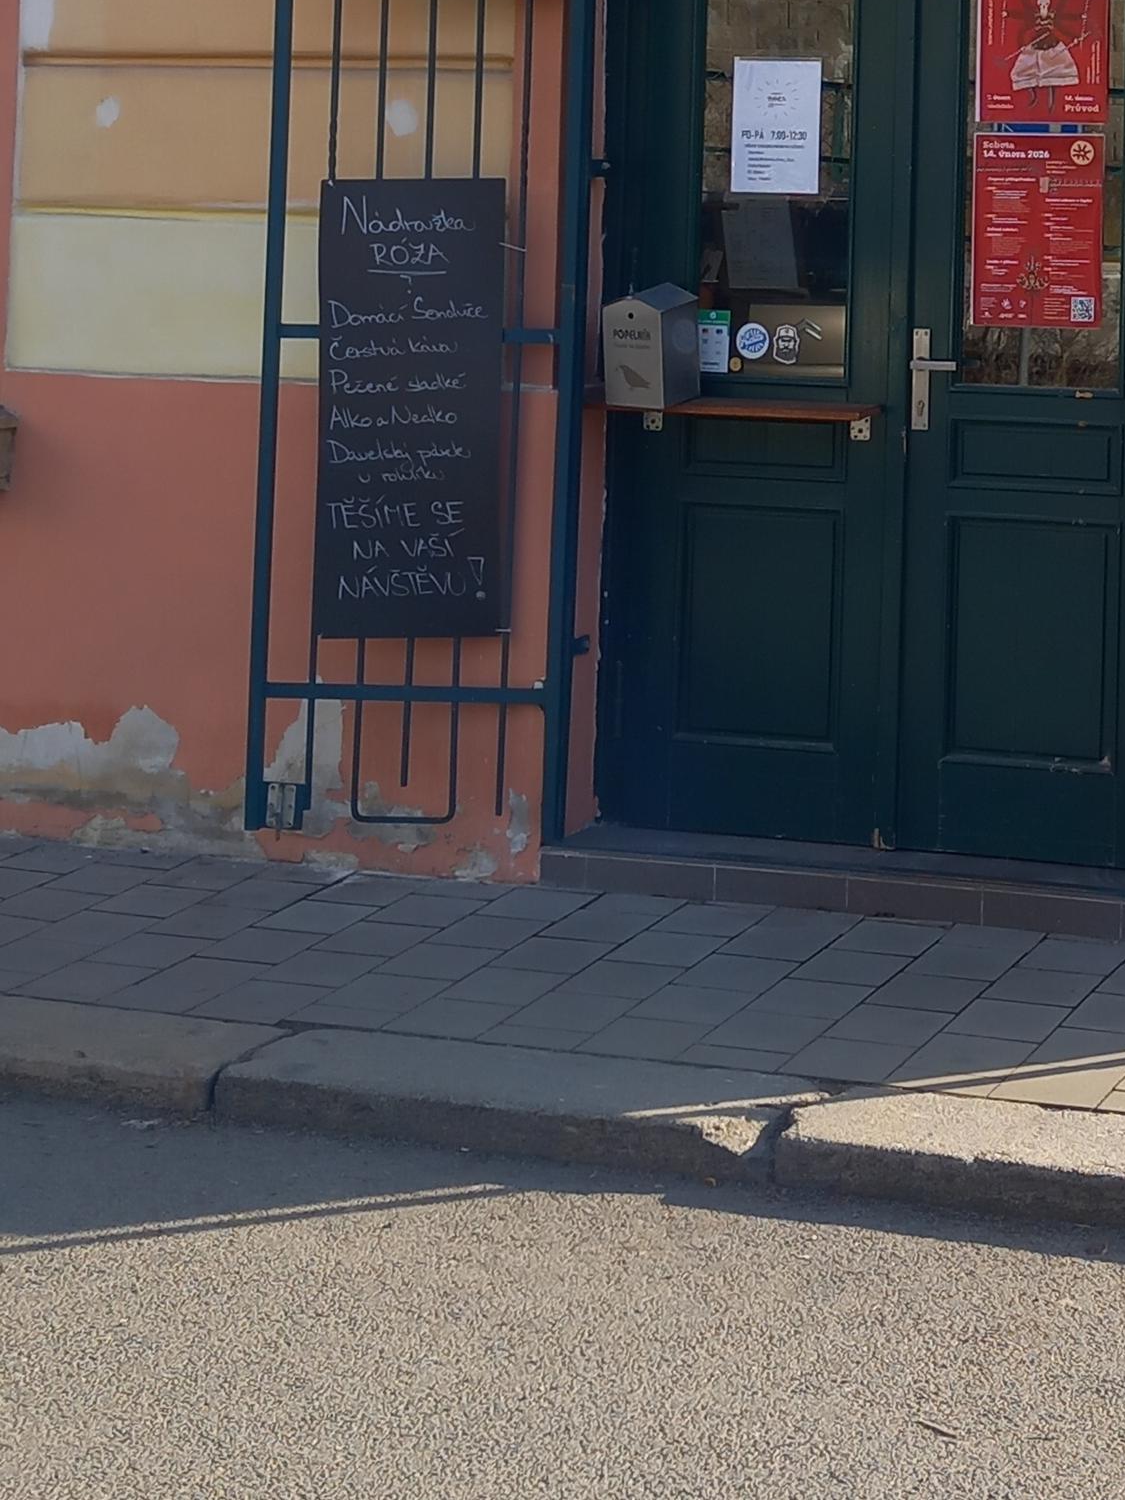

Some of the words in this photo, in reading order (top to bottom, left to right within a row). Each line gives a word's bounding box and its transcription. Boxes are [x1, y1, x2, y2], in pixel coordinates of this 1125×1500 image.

[1027, 150, 1050, 159] 2026
[369, 237, 450, 266] RÓZA
[329, 404, 372, 430] Alko
[326, 494, 421, 529] TĚŠÍME
[430, 501, 465, 526] SE
[352, 539, 390, 560] NA
